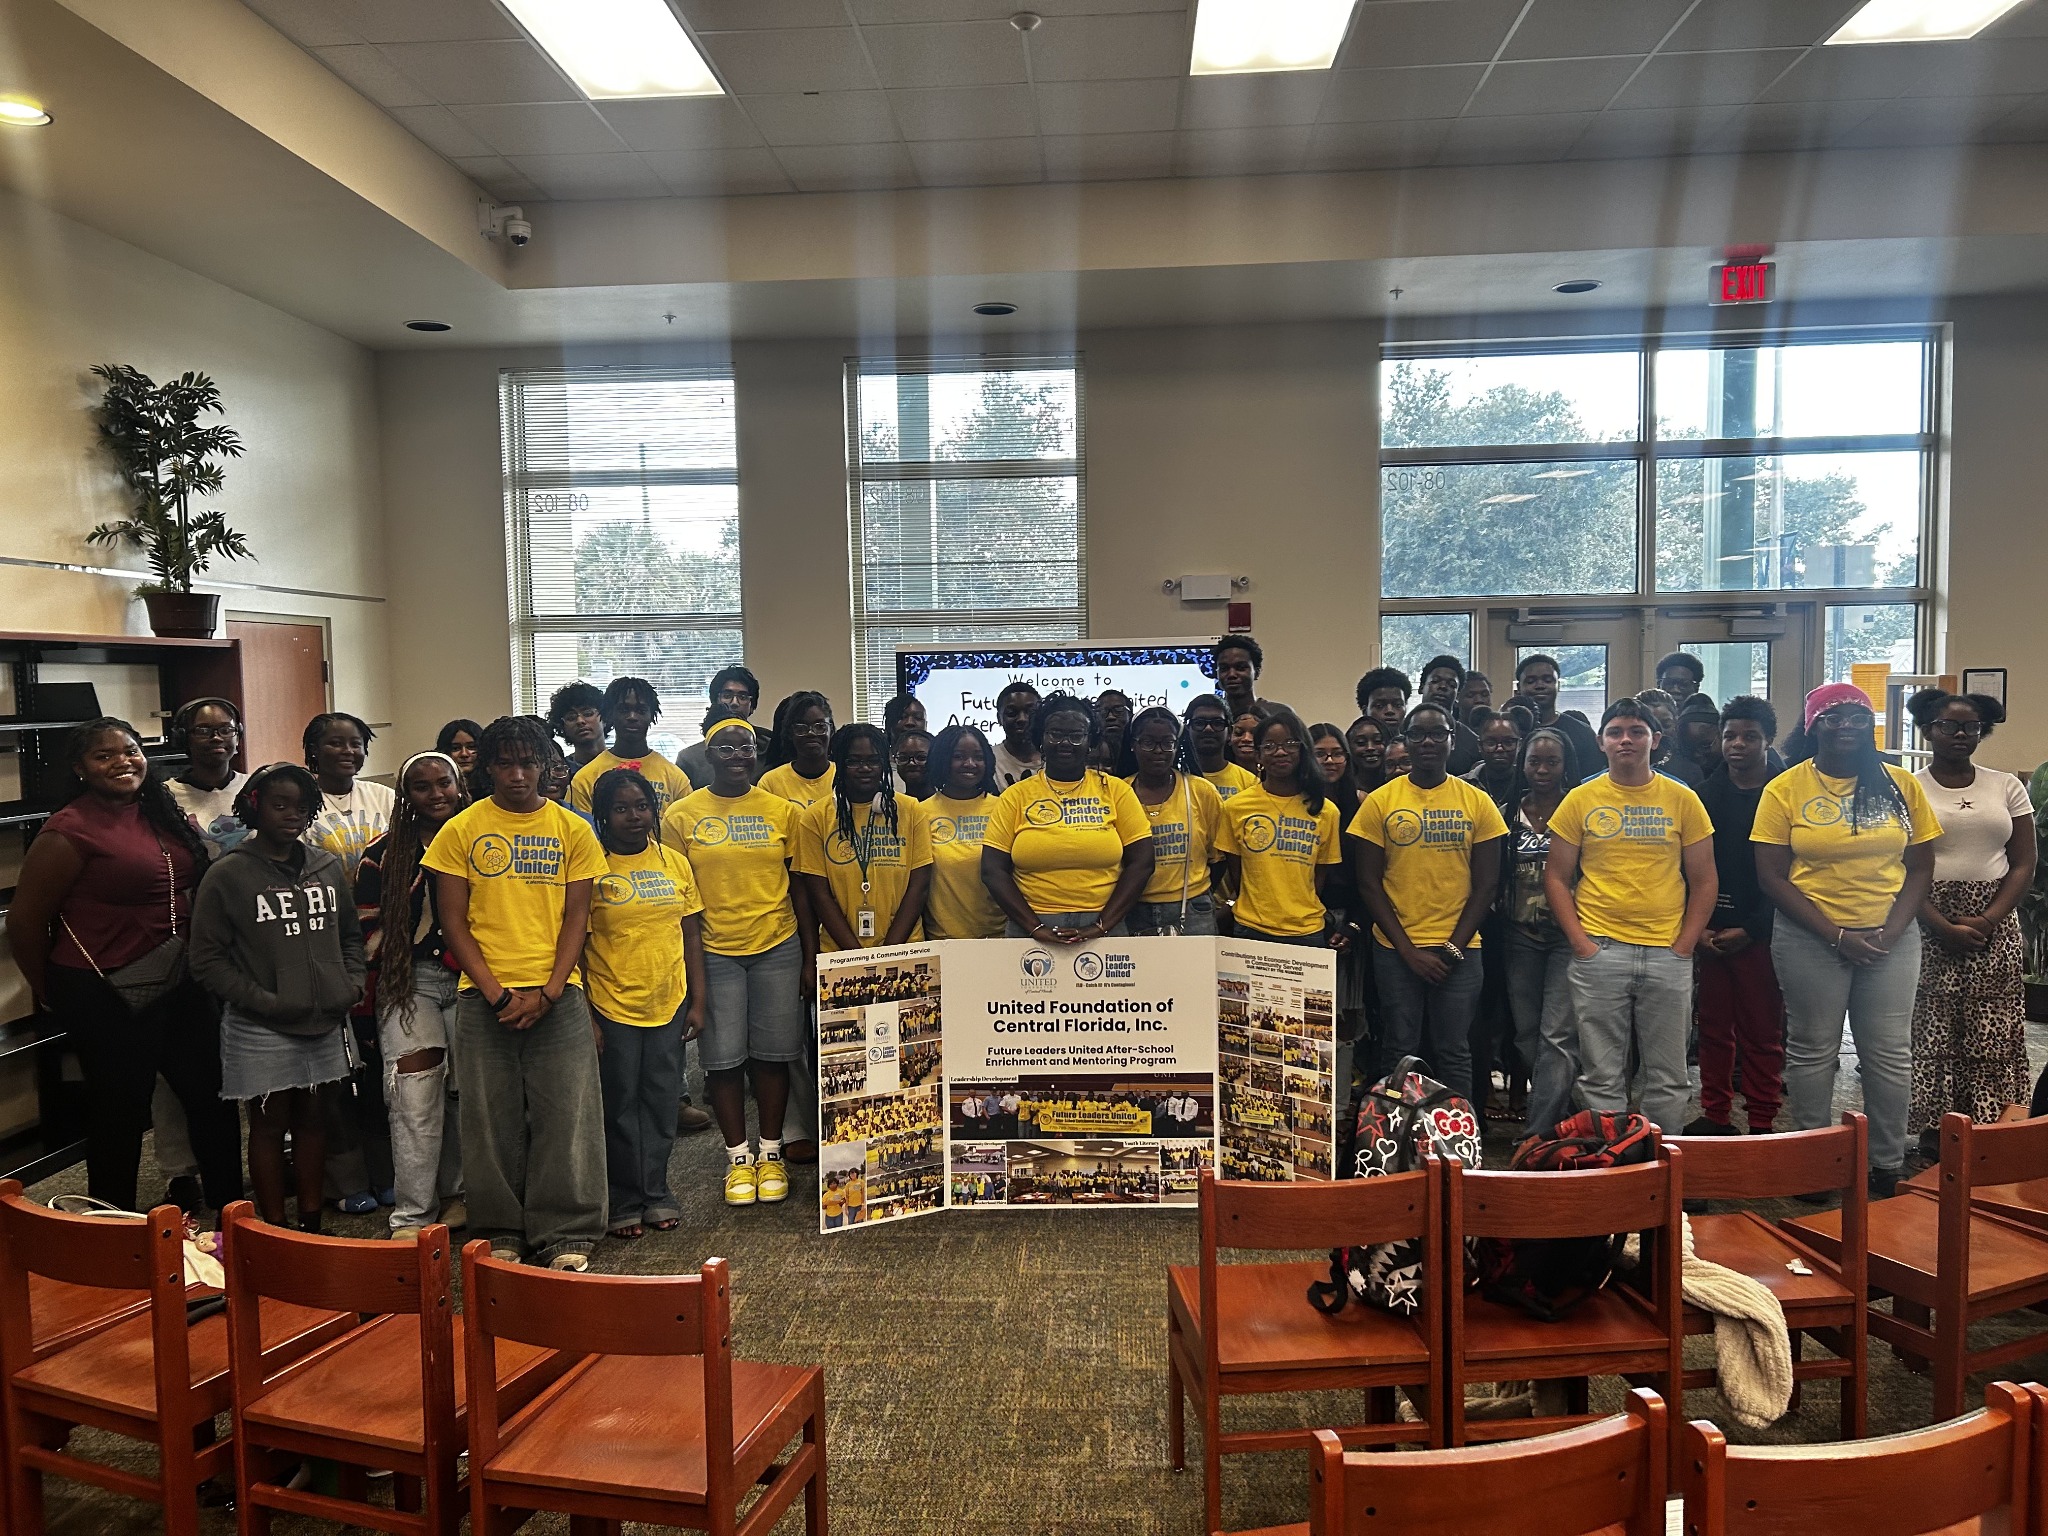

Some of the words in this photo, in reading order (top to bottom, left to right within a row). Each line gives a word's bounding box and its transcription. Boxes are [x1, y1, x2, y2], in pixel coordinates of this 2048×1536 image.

[1722, 264, 1768, 300] EXIT
[1007, 673, 1085, 687] Welcome
[1094, 672, 1112, 686] to
[961, 691, 998, 711] Fut
[1062, 797, 1100, 807] Future
[1063, 805, 1110, 816] Leaders
[1422, 808, 1464, 820] Future
[1624, 805, 1664, 816] Future
[728, 815, 765, 825] Future
[957, 815, 990, 824] Future
[1064, 815, 1104, 825] United
[1278, 814, 1317, 831] Future
[1423, 818, 1473, 831] Leaders
[1622, 815, 1674, 827] Leaders
[729, 823, 775, 834] Leaders
[861, 825, 893, 837] Ftur
[957, 822, 988, 833] Leade
[1152, 822, 1185, 835] uture
[1625, 826, 1666, 837] United
[513, 834, 560, 848] Future
[731, 831, 770, 842] United
[957, 831, 985, 841] Unite
[1152, 832, 1189, 846] eader
[1277, 827, 1321, 846] Leaders
[1424, 830, 1465, 843] United
[870, 847, 901, 858] nited
[1156, 843, 1186, 857] nited
[1277, 838, 1313, 856] United
[514, 860, 560, 876] United
[630, 870, 666, 881] Future
[633, 879, 677, 890] Leaders
[638, 886, 676, 899] United
[829, 955, 870, 965] Programming
[876, 949, 909, 959] Community
[909, 947, 931, 955] Service
[1105, 953, 1130, 962] Future
[1221, 950, 1257, 961] Contributions
[1264, 955, 1291, 965] Economic
[1291, 959, 1329, 970] Development
[1105, 961, 1136, 970] Leaders
[1251, 959, 1281, 970] Community
[1282, 963, 1303, 972] Served
[1105, 969, 1131, 978] United
[1020, 978, 1058, 987] UNITED
[987, 1000, 1045, 1015] United
[1049, 998, 1152, 1014] Foundation
[1156, 998, 1174, 1013] of
[993, 1018, 1060, 1033] Central
[1064, 1017, 1131, 1034] Florida,
[1135, 1018, 1168, 1032] Inc.
[987, 1046, 1022, 1056] Future
[1024, 1046, 1066, 1055] Leaders
[1068, 1045, 1104, 1055] United
[1105, 1044, 1174, 1054] After-School
[985, 1057, 1047, 1067] Enrichment
[1049, 1056, 1070, 1066] and
[1072, 1056, 1127, 1068] Mentoring
[1129, 1055, 1177, 1067] Program
[981, 1075, 1018, 1083] Development
[1052, 1110, 1077, 1119] Future
[1078, 1111, 1110, 1120] Leaders
[1111, 1112, 1138, 1120] United
